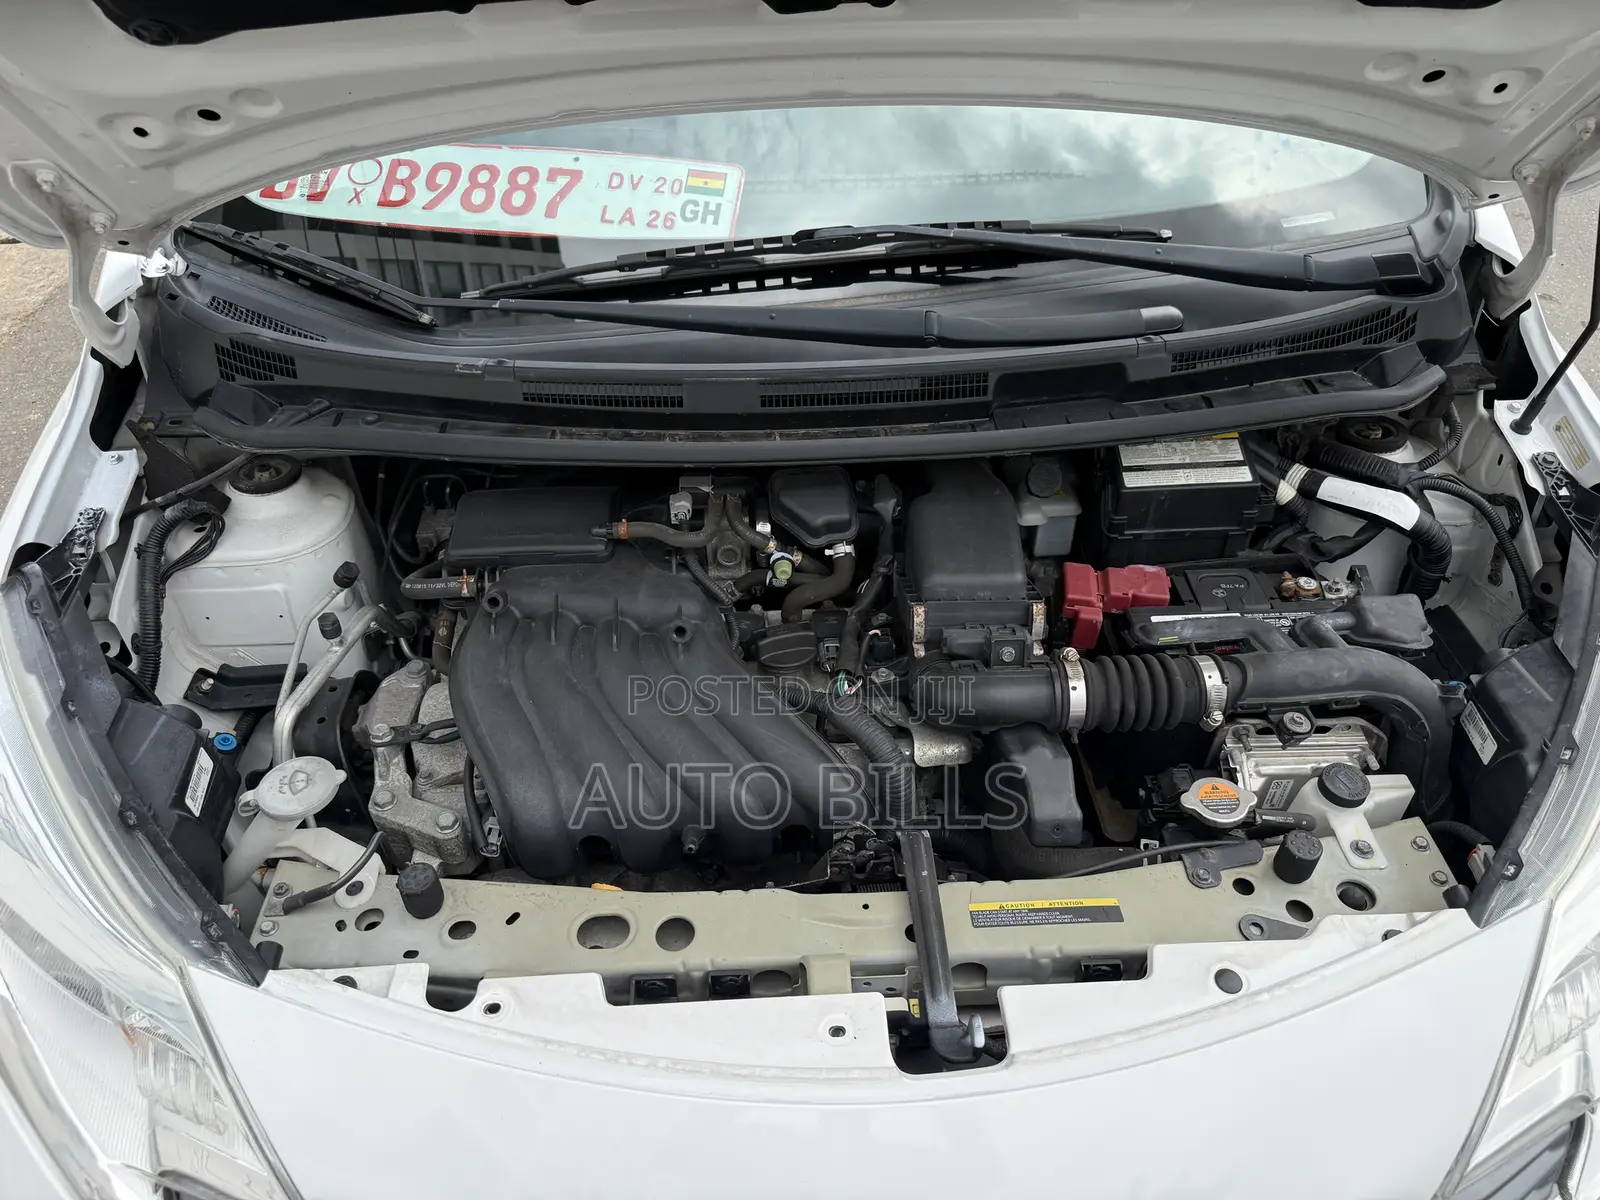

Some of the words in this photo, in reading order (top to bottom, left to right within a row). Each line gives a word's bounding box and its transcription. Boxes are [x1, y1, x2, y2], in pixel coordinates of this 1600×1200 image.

[377, 158, 584, 220] B9887
[607, 172, 644, 191] DV
[654, 176, 684, 196] 20
[600, 205, 636, 227] LA
[646, 210, 677, 230] 26
[680, 199, 722, 226] GH
